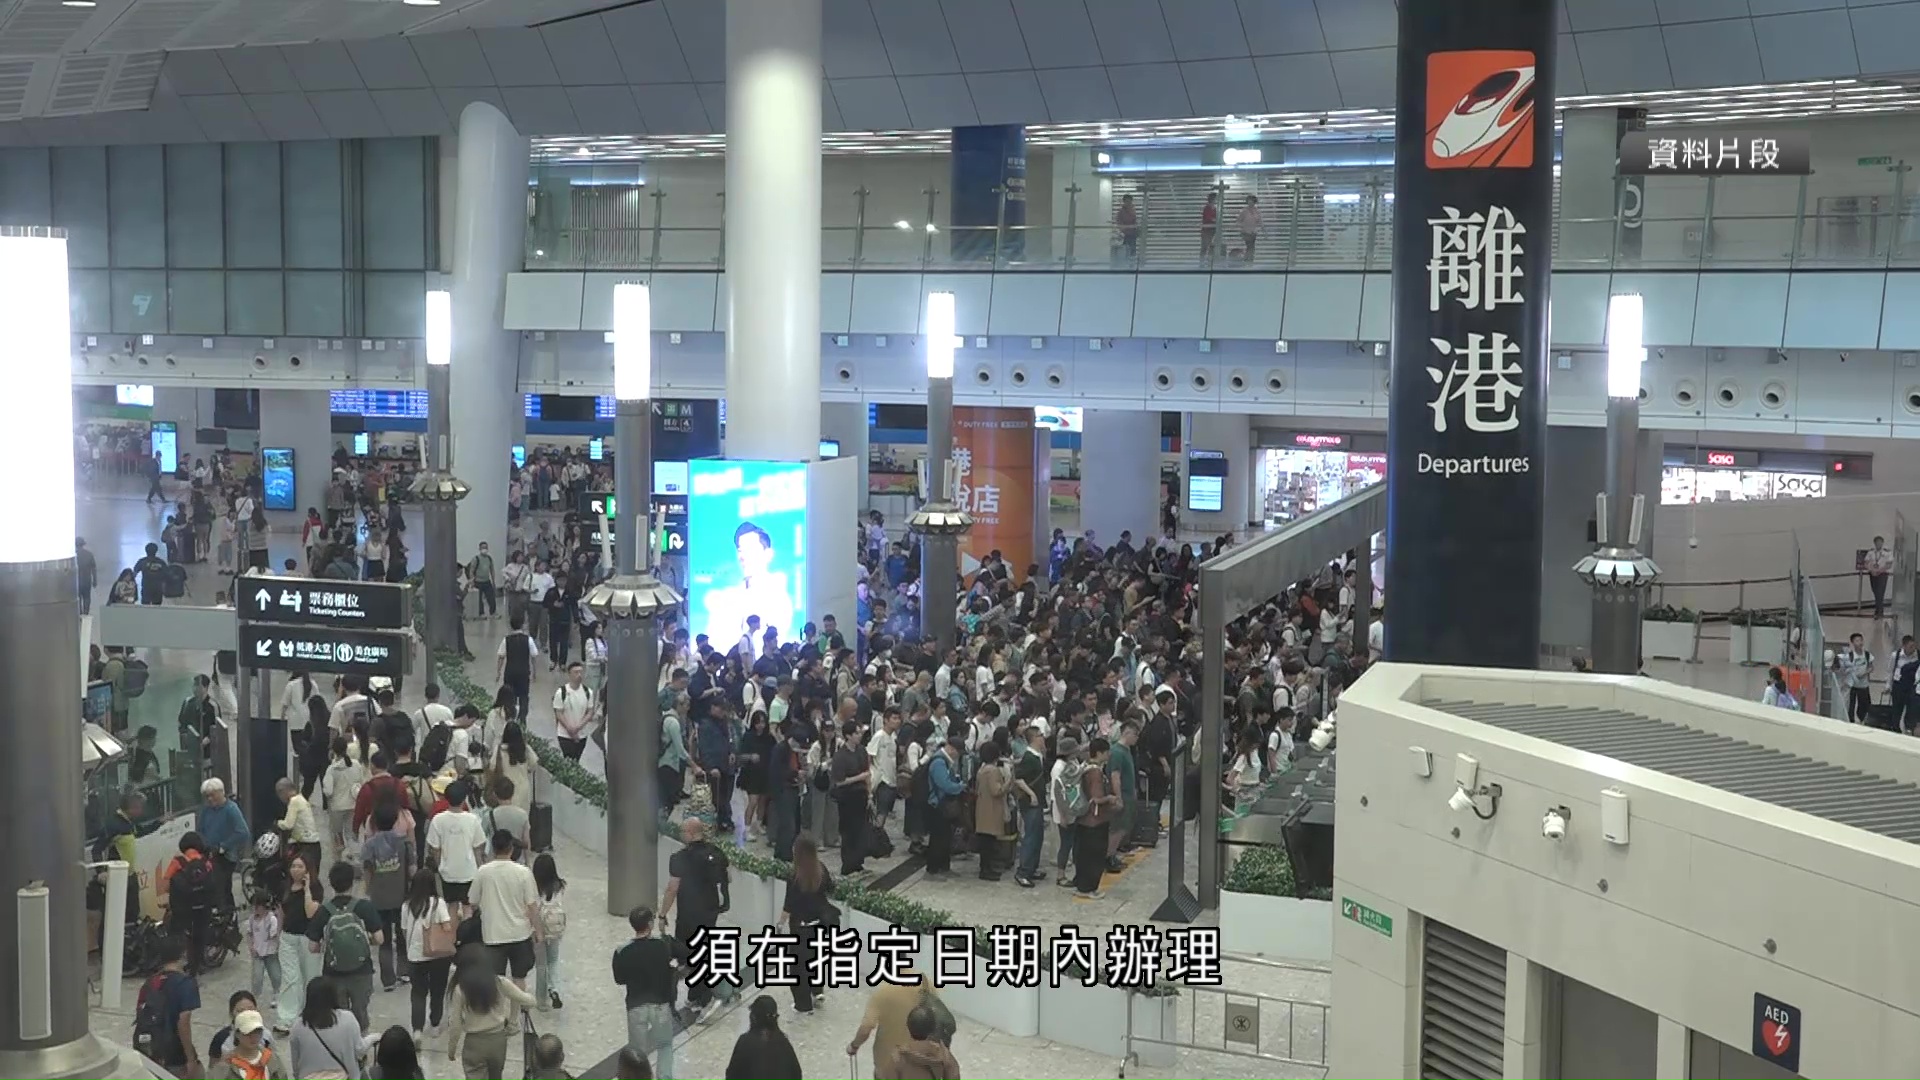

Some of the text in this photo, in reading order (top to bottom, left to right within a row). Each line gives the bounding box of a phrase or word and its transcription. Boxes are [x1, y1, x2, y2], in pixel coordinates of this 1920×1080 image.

[1426, 205, 1527, 433] 離港
[1417, 453, 1530, 479] Departures
[309, 607, 365, 617] Ticketing Counters
[1764, 1004, 1789, 1025] AED
